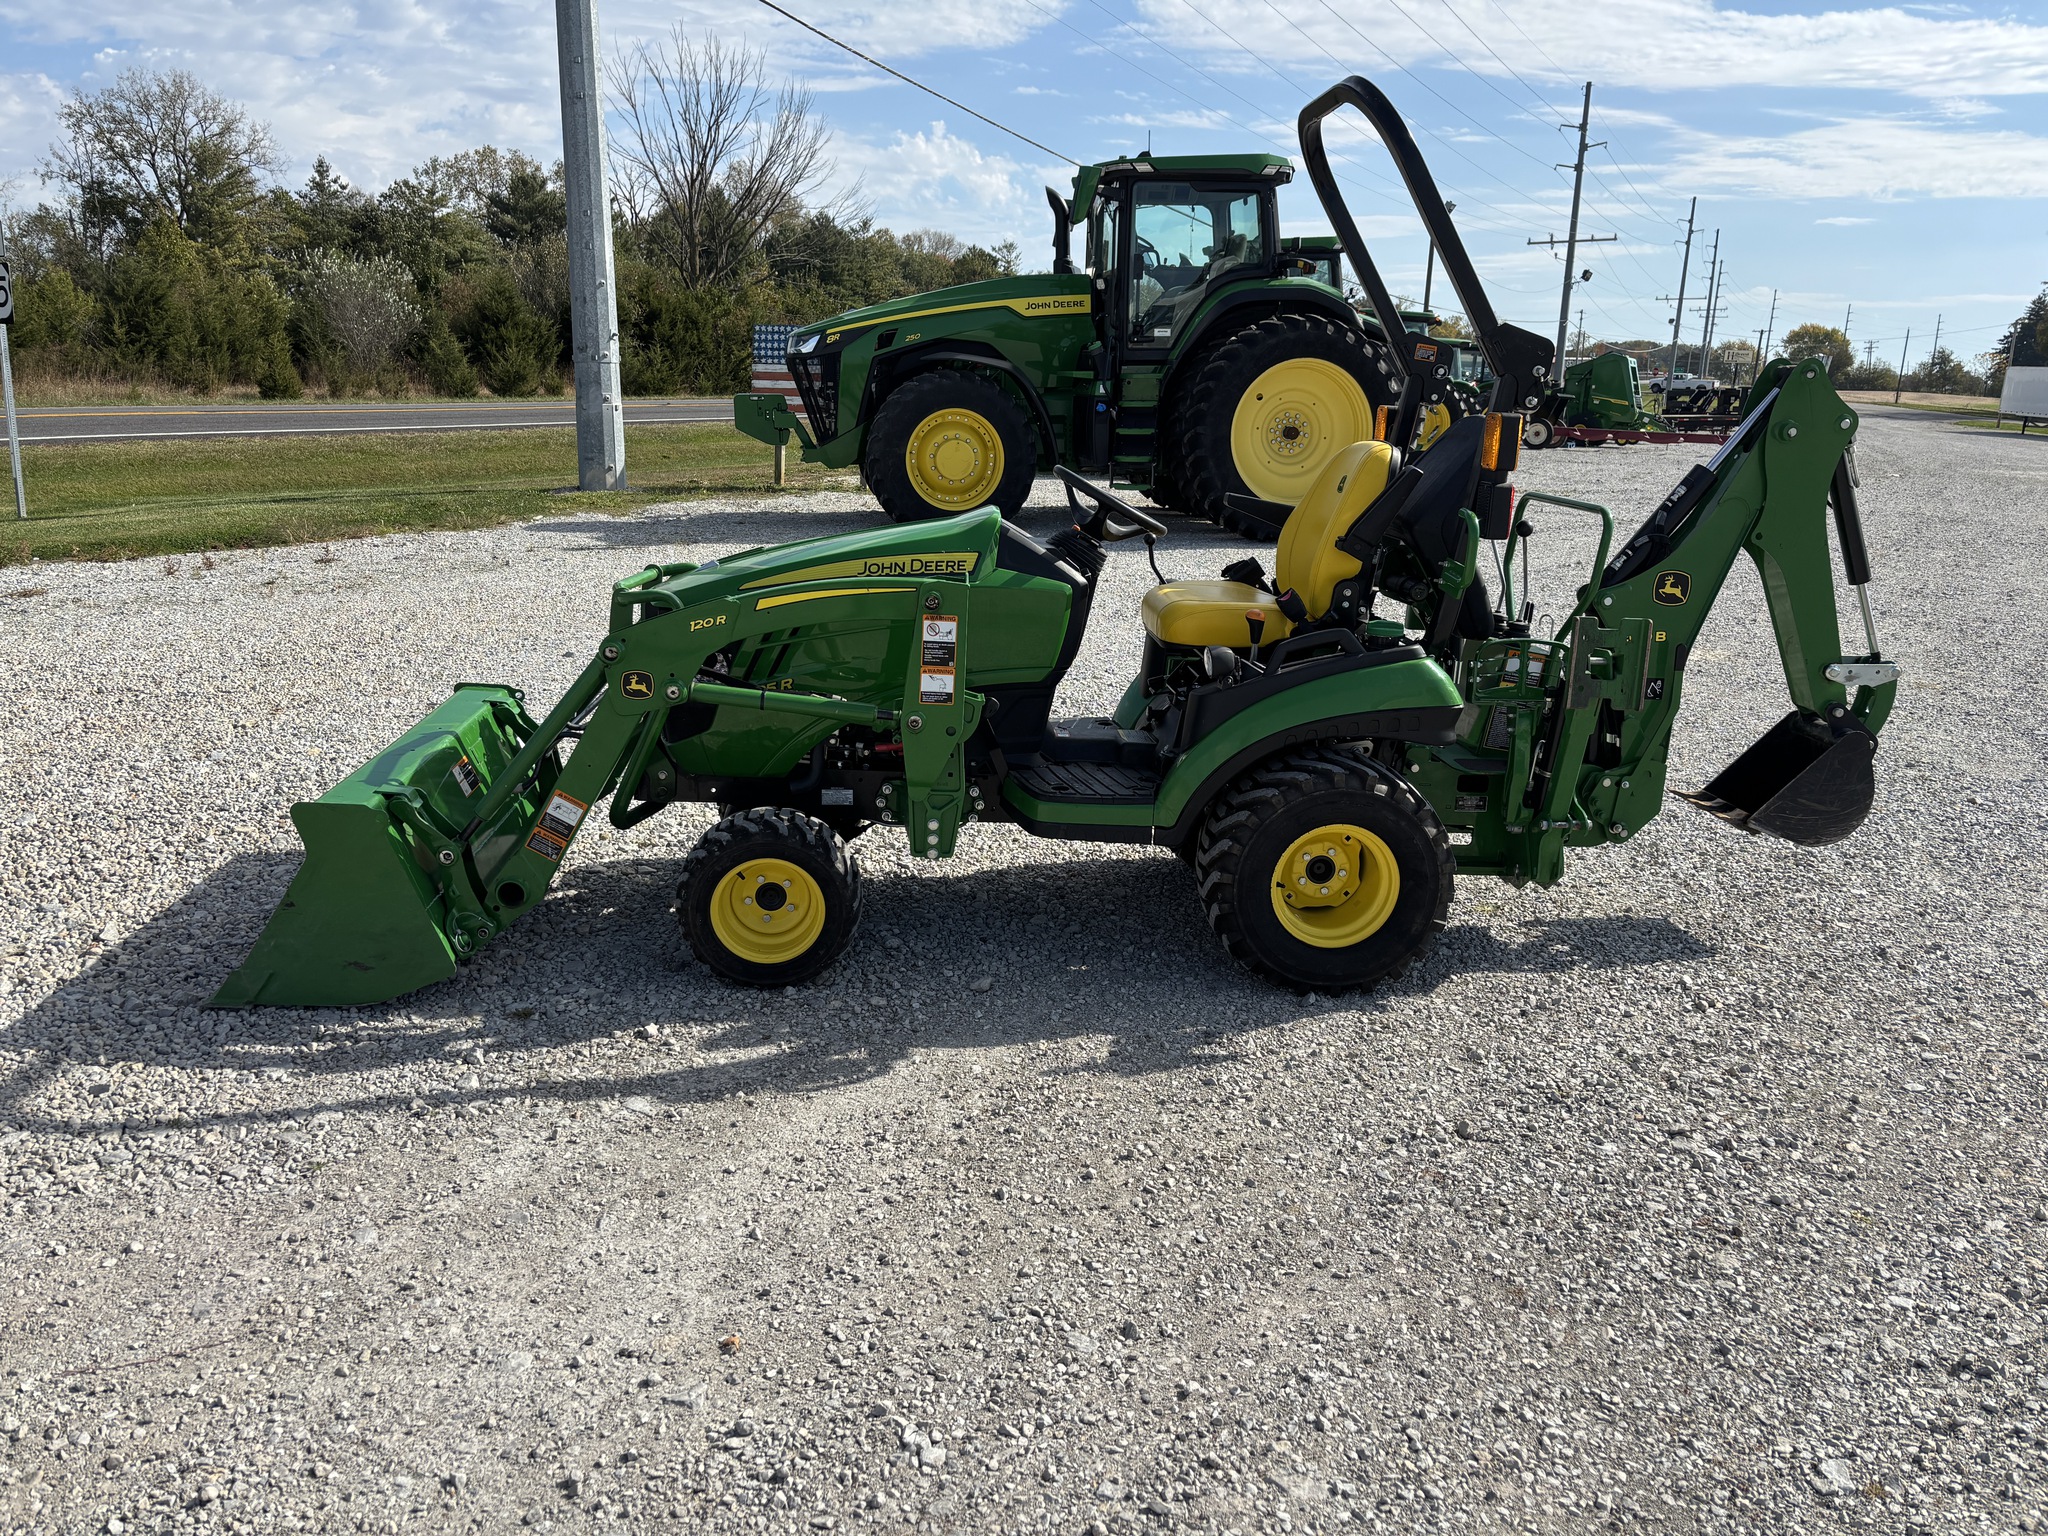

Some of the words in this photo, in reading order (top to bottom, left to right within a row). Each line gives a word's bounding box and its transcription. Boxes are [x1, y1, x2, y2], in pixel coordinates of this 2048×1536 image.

[1025, 301, 1051, 310] JOHN
[1053, 300, 1086, 309] DEERE
[826, 333, 840, 344] 8R
[905, 333, 921, 342] 250
[857, 561, 906, 576] JOHN
[910, 559, 967, 573] DEERE
